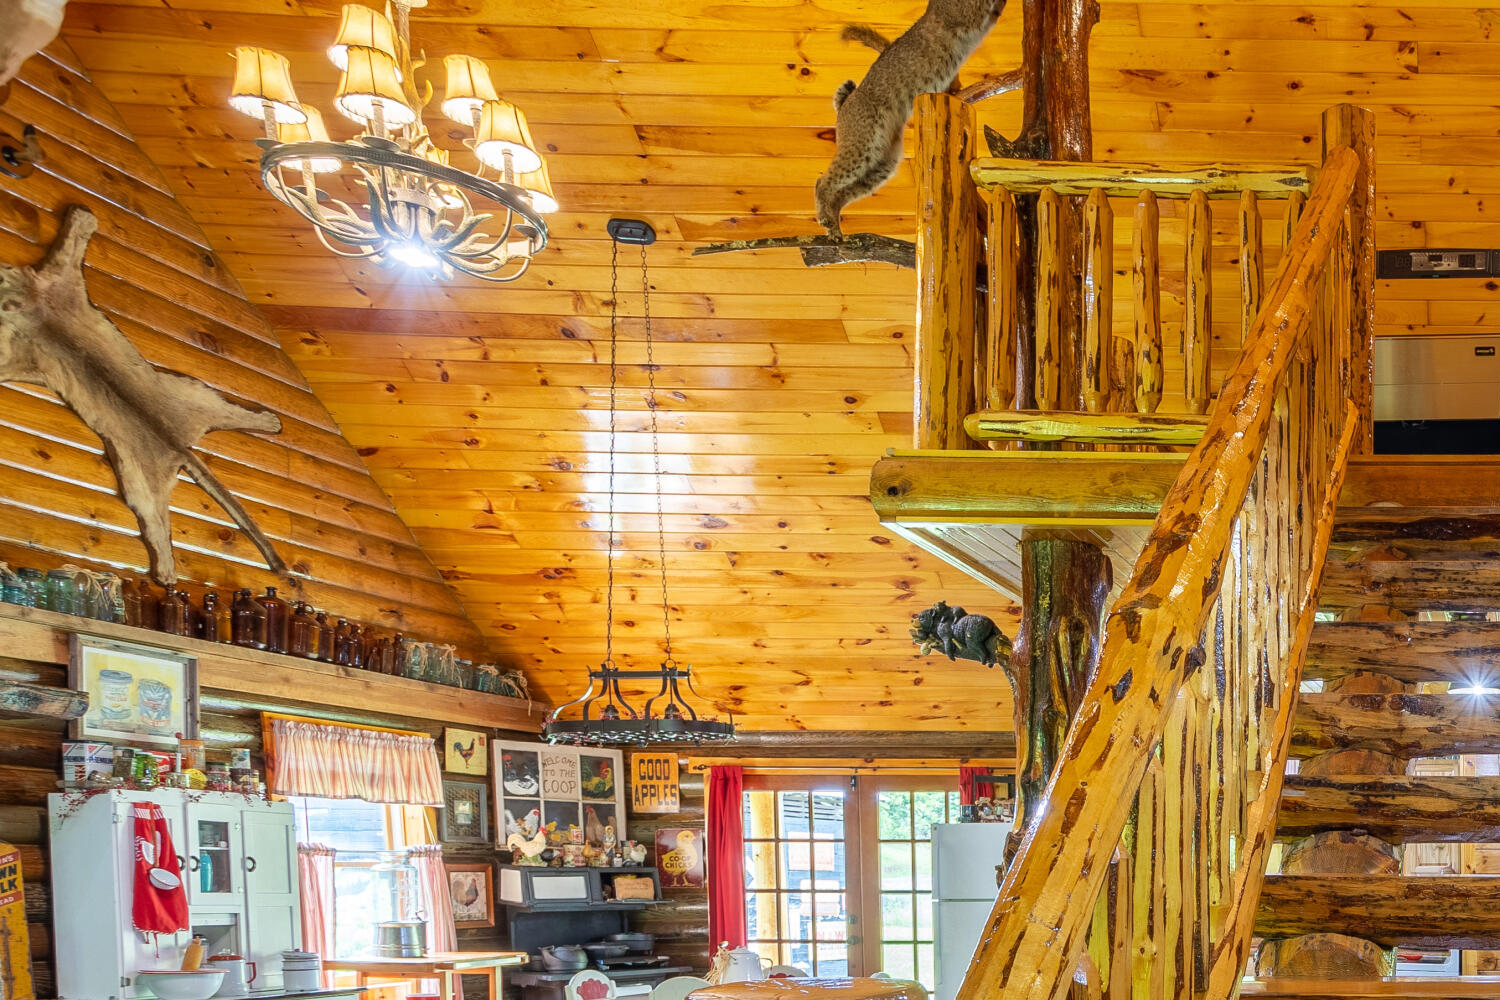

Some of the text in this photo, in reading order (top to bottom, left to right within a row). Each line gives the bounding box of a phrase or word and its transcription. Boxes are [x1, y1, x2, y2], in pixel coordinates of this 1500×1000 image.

[542, 756, 576, 769] WELCOME
[638, 758, 670, 780] GOOD
[543, 768, 576, 778] TO THE
[542, 780, 577, 794] COOP
[634, 783, 677, 806] APPLES
